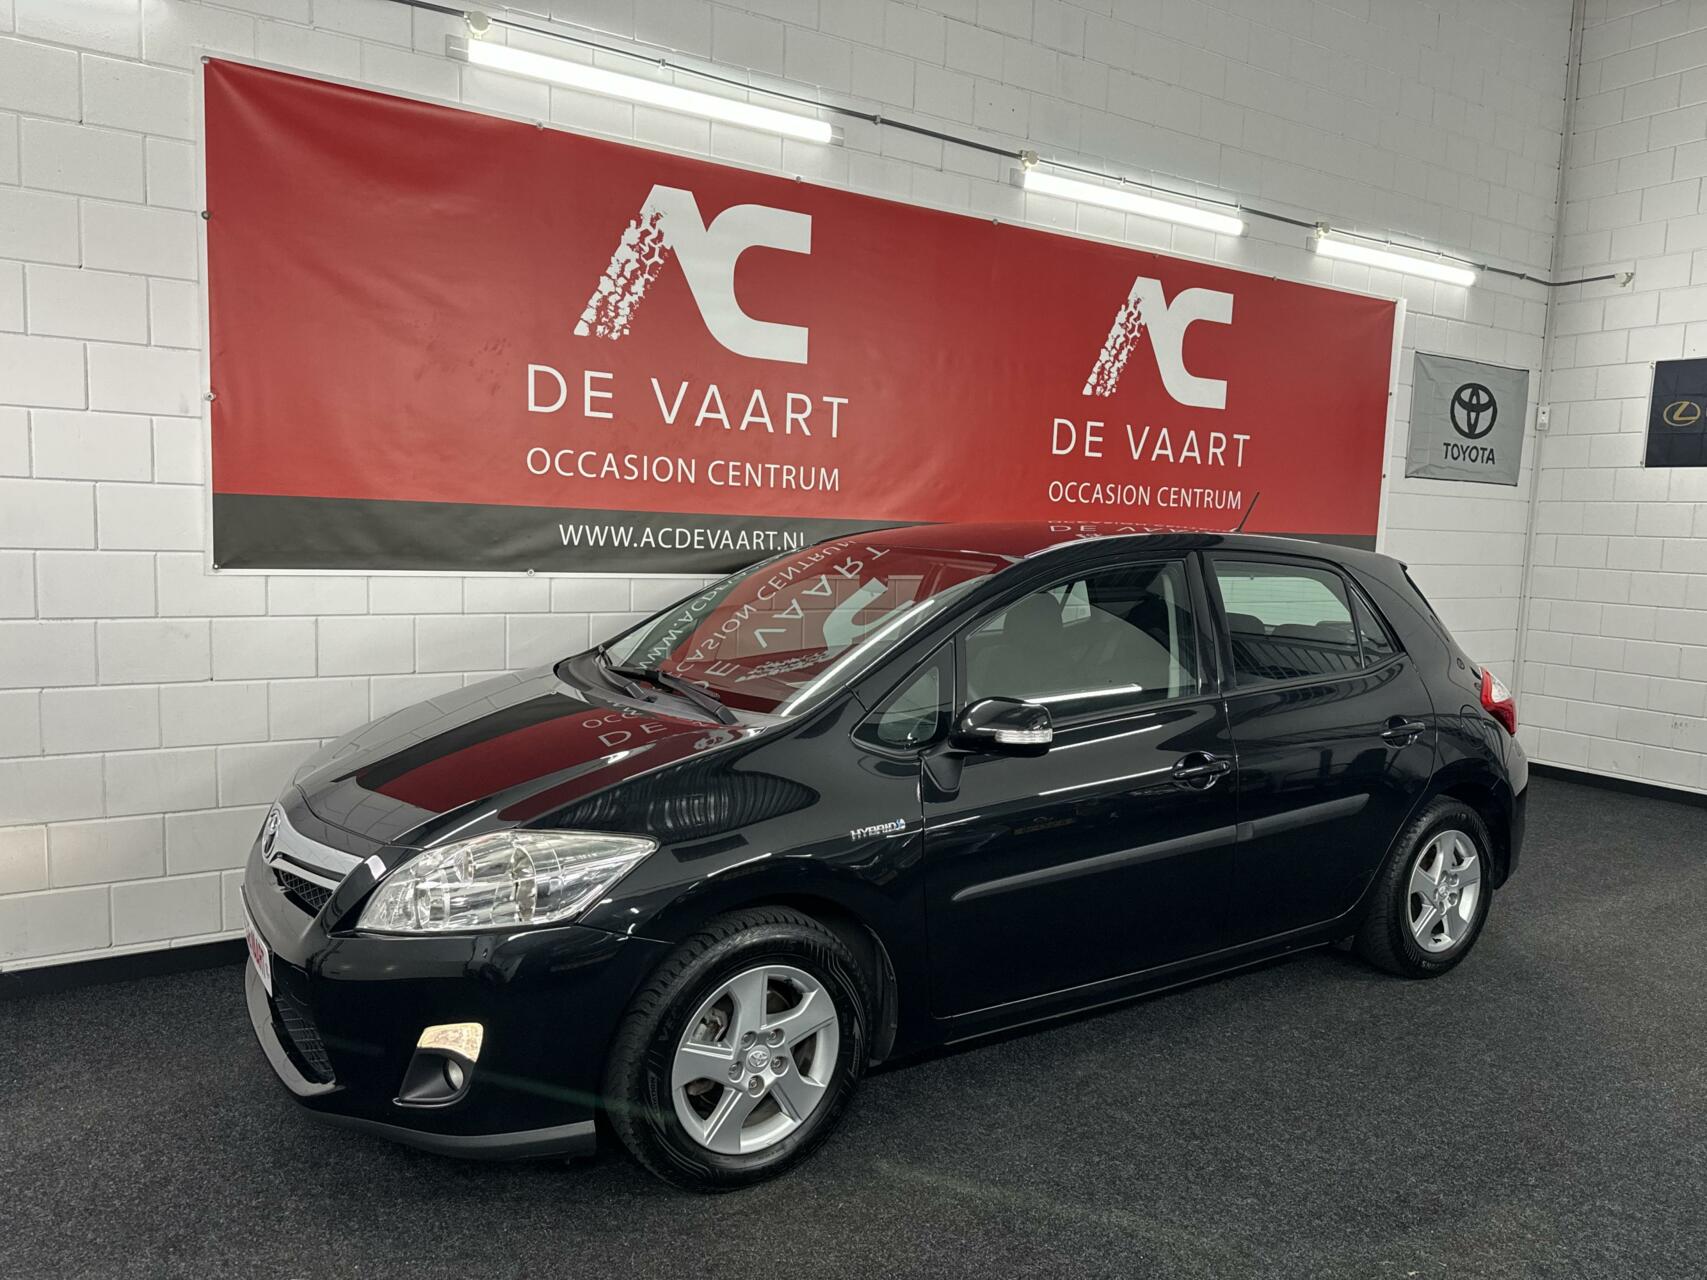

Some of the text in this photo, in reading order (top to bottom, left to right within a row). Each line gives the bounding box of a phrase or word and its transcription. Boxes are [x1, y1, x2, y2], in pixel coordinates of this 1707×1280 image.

[573, 183, 812, 364] AC
[1082, 275, 1234, 410] AC
[527, 363, 849, 438] DE VAART
[1051, 417, 1251, 468] DE VAART
[1443, 442, 1496, 465] TOYOTA
[526, 447, 840, 492] OCCASION CENTRUM
[1048, 480, 1242, 510] OCCASION CENTRUM
[850, 821, 898, 841] HYBRID
